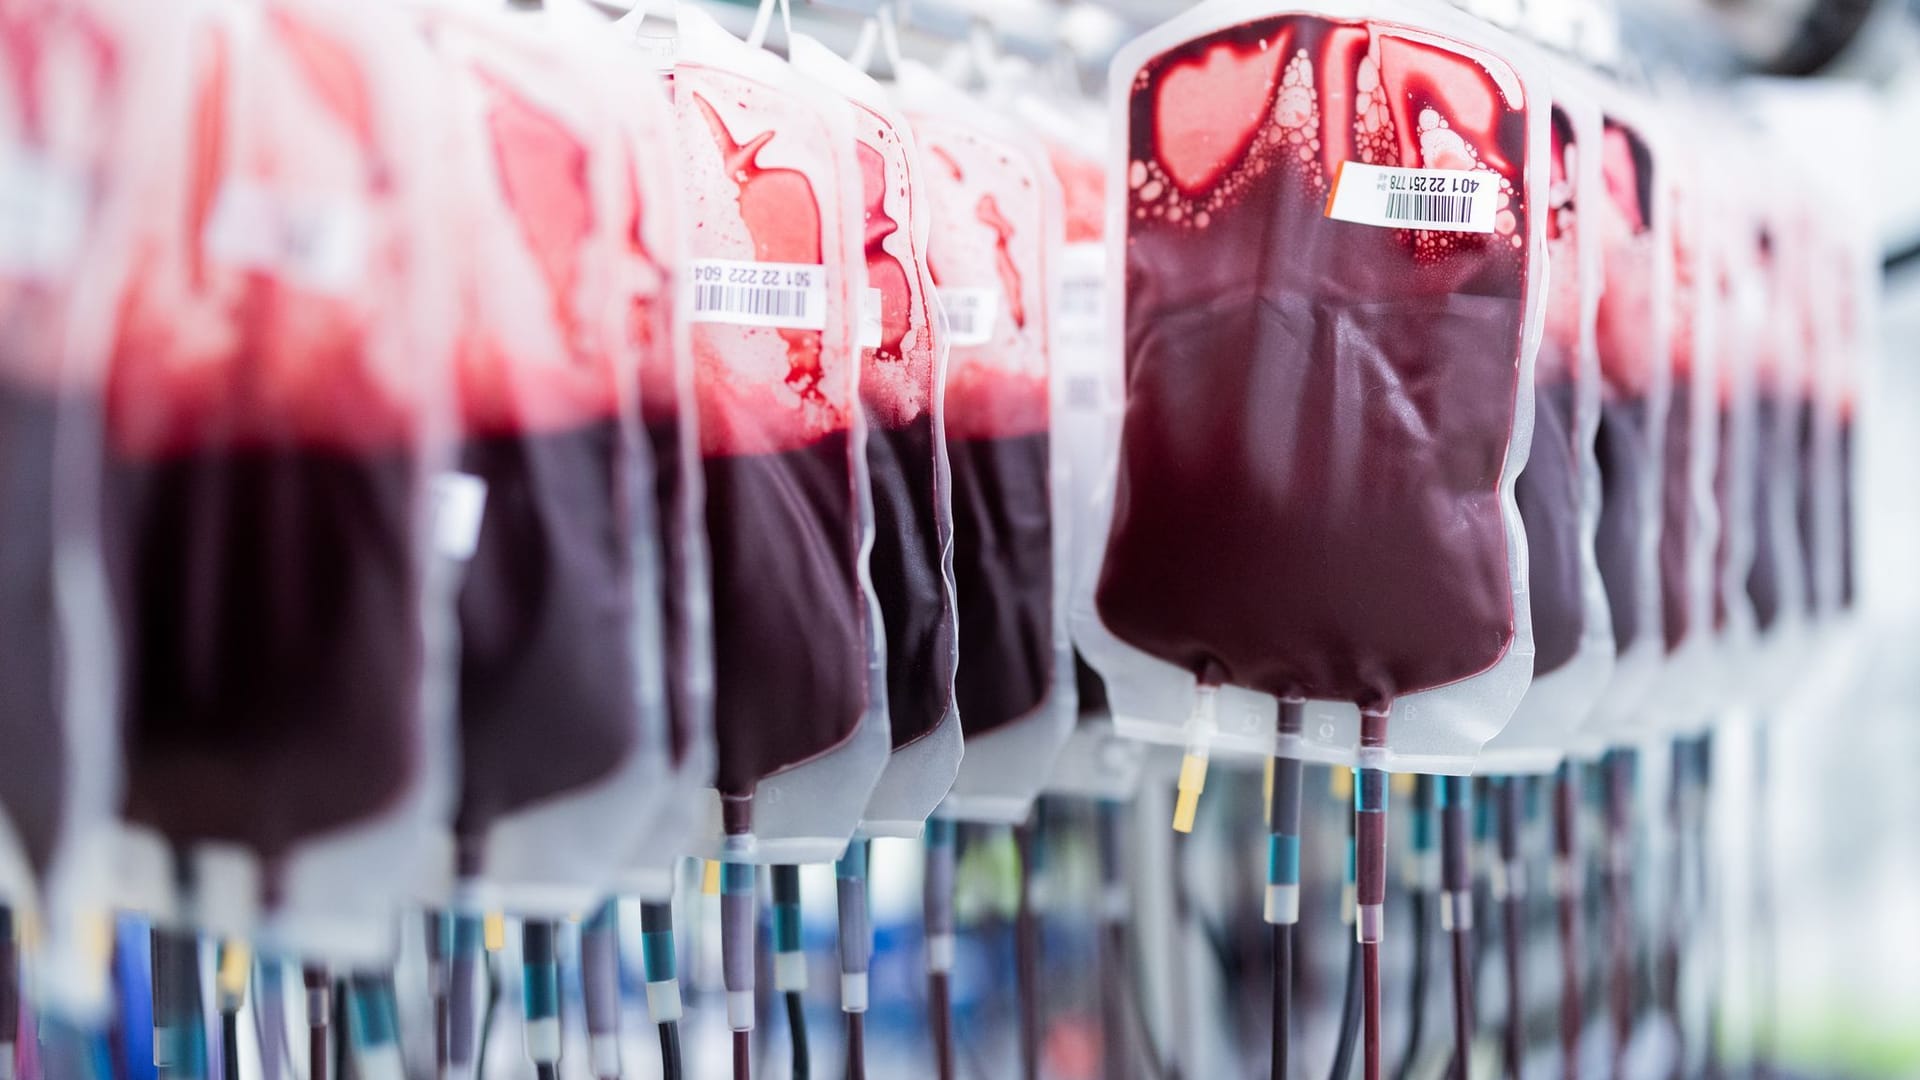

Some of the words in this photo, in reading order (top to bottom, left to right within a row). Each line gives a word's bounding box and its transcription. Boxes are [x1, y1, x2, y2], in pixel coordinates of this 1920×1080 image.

[1390, 175, 1407, 190] 778
[1409, 176, 1427, 192] 251
[1429, 177, 1446, 193] 22
[1452, 178, 1480, 194] 401
[695, 266, 722, 282] 604
[728, 268, 757, 284] 222
[761, 270, 780, 286] 22
[786, 271, 811, 287] 501
